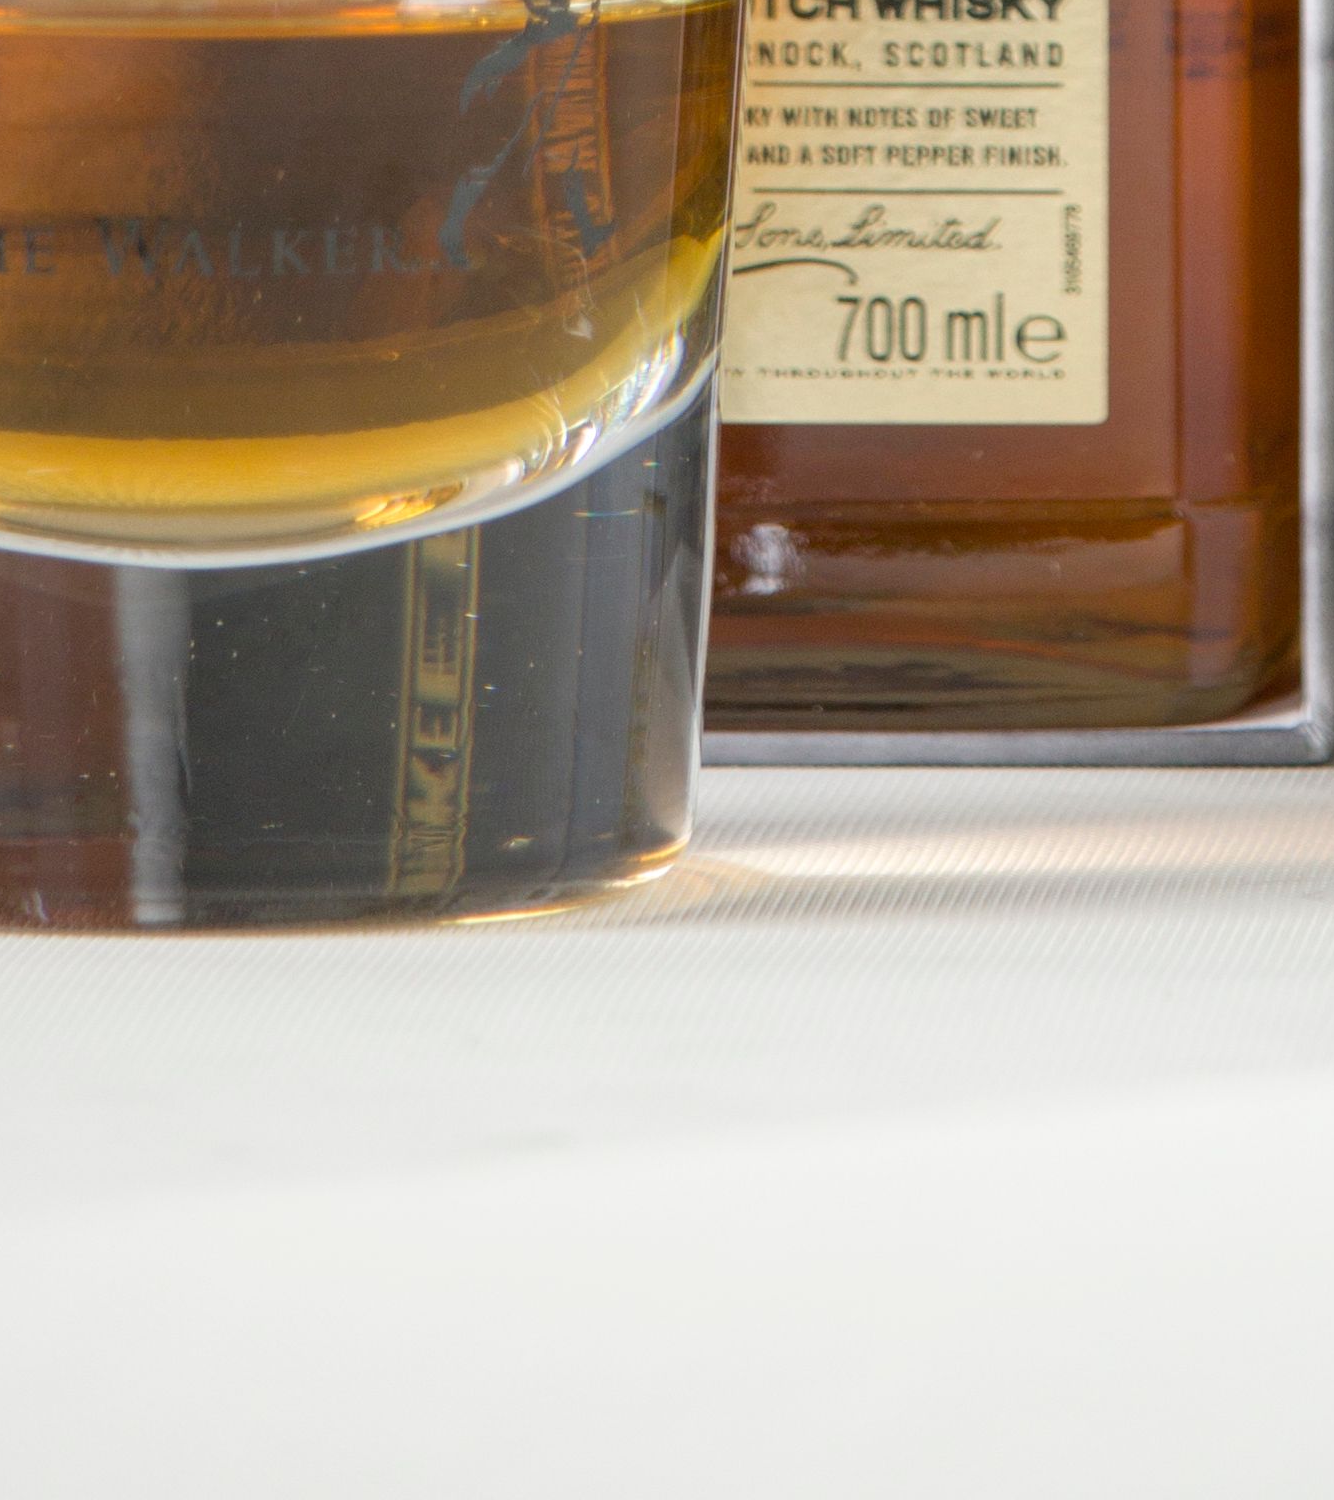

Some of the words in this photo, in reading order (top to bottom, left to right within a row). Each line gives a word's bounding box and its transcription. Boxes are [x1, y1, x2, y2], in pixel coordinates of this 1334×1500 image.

[747, 41, 862, 71] NOCK,
[883, 41, 1064, 68] SCOTLAND
[782, 106, 838, 128] WITH
[847, 106, 918, 128] NOTES
[927, 106, 955, 129] OF
[965, 106, 1038, 129] SWEET
[747, 142, 791, 166] AND
[800, 143, 814, 165] A
[822, 142, 876, 166] SOFT
[885, 143, 974, 167] PEPPER
[836, 296, 927, 363] 700
[759, 366, 920, 380] THROUGHOUT
[930, 366, 975, 380] THE
[988, 366, 1067, 380] WORLD
